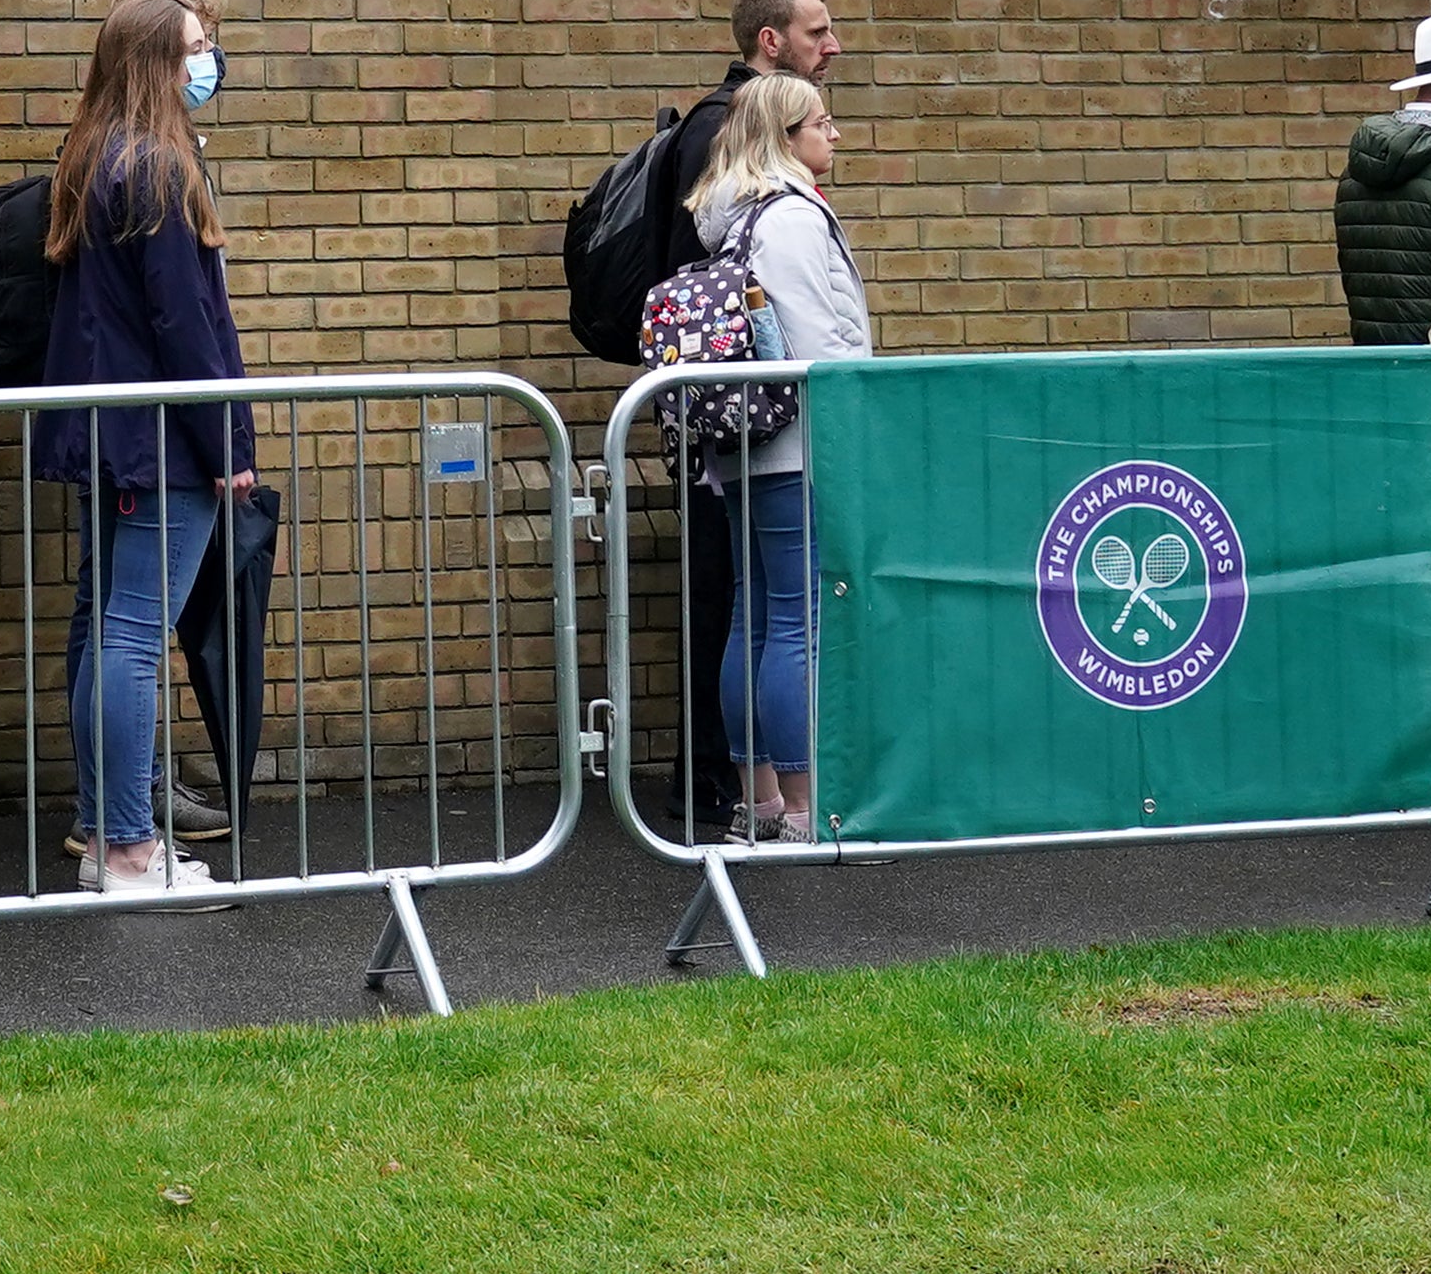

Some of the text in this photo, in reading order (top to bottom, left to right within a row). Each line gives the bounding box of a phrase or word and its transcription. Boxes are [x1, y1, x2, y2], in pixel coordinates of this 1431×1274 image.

[1048, 473, 1234, 581] THE CHAMPIONSHIPS
[1076, 641, 1216, 698] WIMBLEDON
